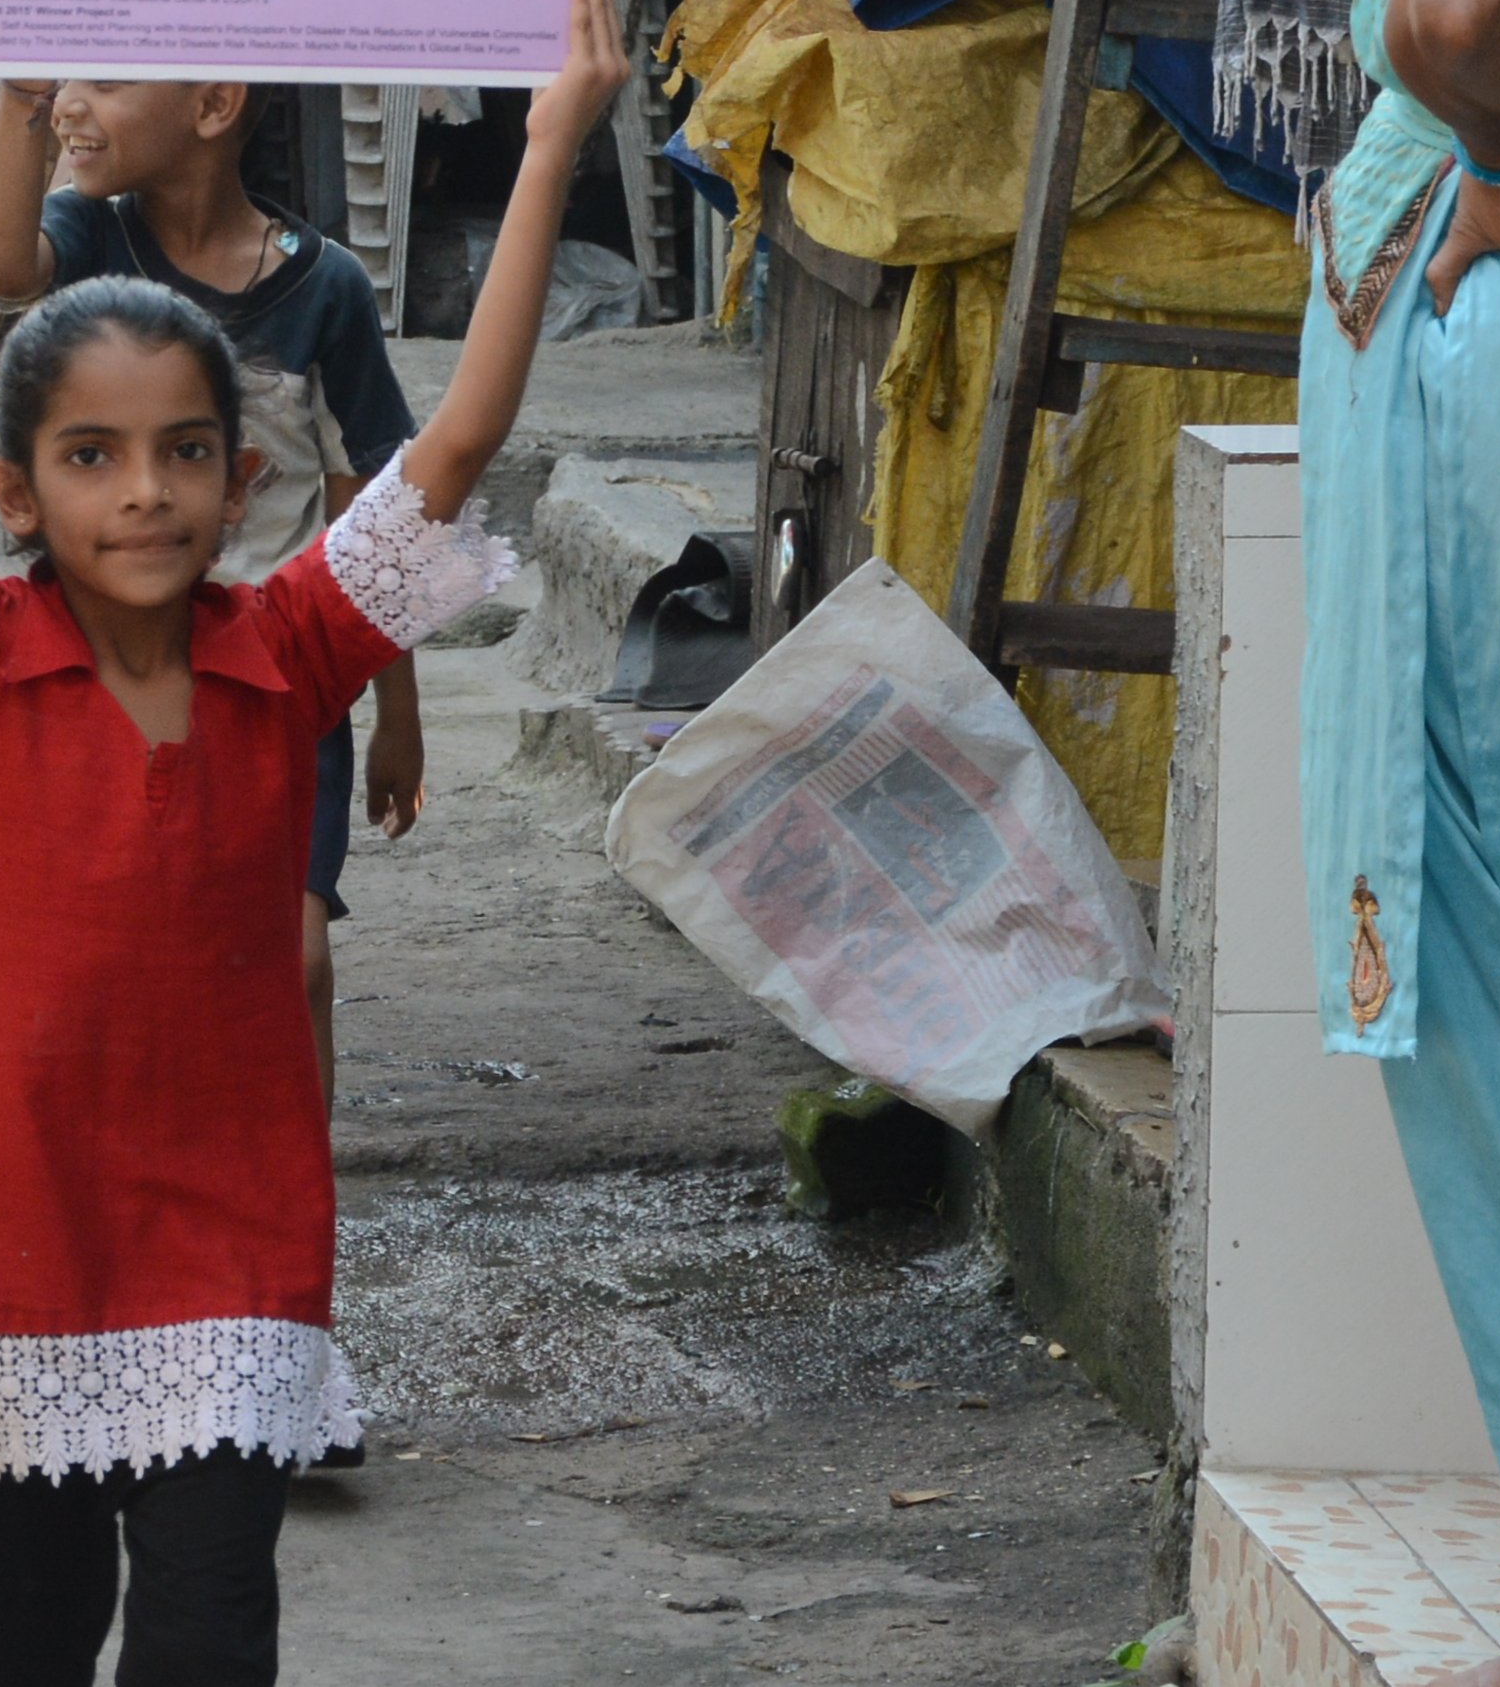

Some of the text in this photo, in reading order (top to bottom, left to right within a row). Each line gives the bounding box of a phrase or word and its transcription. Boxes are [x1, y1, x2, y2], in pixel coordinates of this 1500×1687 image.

[35, 5, 72, 16] Winner
[75, 6, 113, 19] Project
[117, 7, 130, 17] on
[1, 19, 19, 30] Self
[23, 19, 83, 31] Assessment
[86, 21, 103, 32] and
[108, 21, 151, 34] Planning
[154, 22, 173, 33] with
[177, 22, 221, 34] Women's
[225, 23, 286, 37] Participation
[288, 25, 302, 36] for
[305, 25, 346, 37] Disaster
[349, 26, 370, 37] Risk
[373, 26, 423, 38] Reduction
[438, 28, 490, 39] Vulnerable
[20, 35, 31, 47] by
[35, 35, 53, 46] The
[56, 36, 88, 47] United
[92, 36, 128, 47] Nations
[132, 37, 160, 48] Office
[164, 38, 176, 48] for
[180, 38, 219, 49] Disaster
[224, 39, 245, 50] Risk
[305, 41, 340, 51] Munich
[343, 41, 357, 52] Re
[360, 42, 417, 53] Foundation
[428, 43, 460, 54] Global
[463, 44, 484, 54] Risk
[487, 44, 520, 55] Forum
